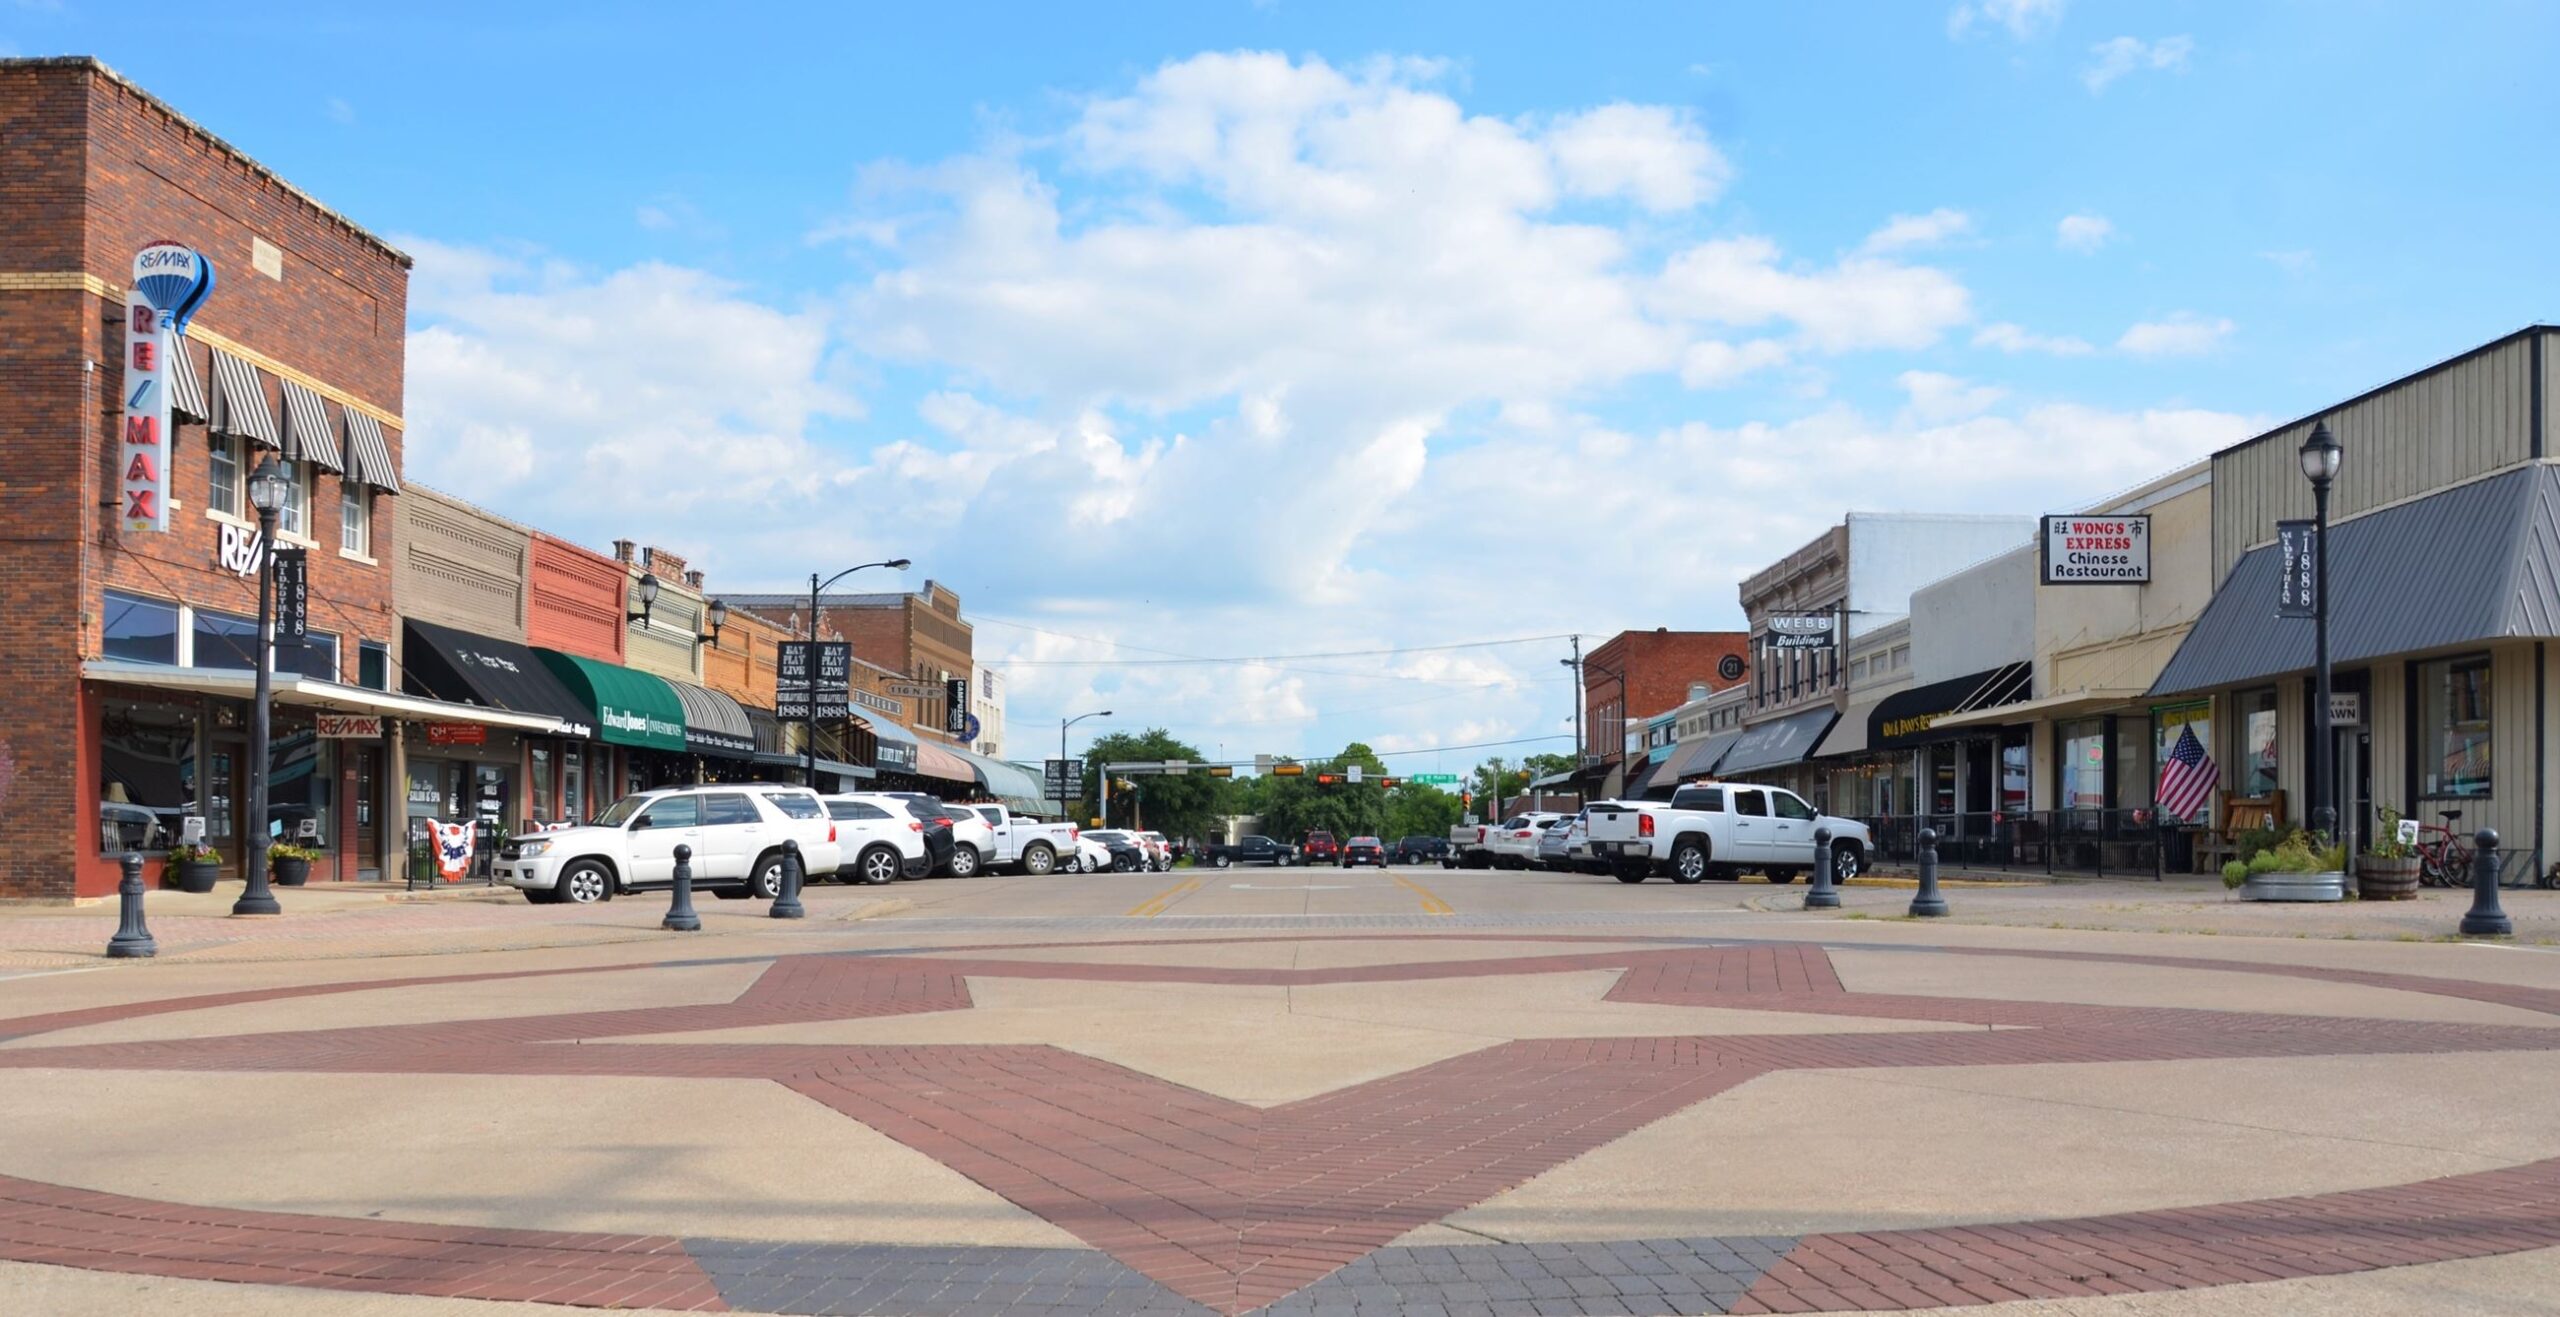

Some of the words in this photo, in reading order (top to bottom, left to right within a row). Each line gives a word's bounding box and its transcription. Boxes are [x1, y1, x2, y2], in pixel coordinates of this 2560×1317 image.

[140, 250, 190, 269] RE/MAX
[126, 304, 158, 519] RE/MAX
[2073, 523, 2125, 534] WONG'S
[2066, 538, 2131, 549] EXPRESS
[2069, 552, 2128, 564] Chinese
[2056, 565, 2142, 577] Restaurant
[2282, 532, 2293, 604] MIDLOTHIAN
[2301, 537, 2310, 606] 1888
[277, 561, 289, 633] MIDLOTHIAN
[295, 567, 305, 635] 1888
[1774, 617, 1828, 628] WEBB
[1777, 635, 1824, 646] Buildings
[786, 646, 805, 654] EAT
[824, 647, 843, 655] EAT
[783, 655, 806, 664] PLAY
[822, 656, 844, 665] PLAY
[783, 666, 805, 675] LIVE
[821, 667, 843, 676] LIVE
[777, 705, 809, 717] 1888
[817, 706, 847, 718] 1888
[2330, 709, 2355, 719] AWN
[319, 717, 379, 735] RE/MAX
